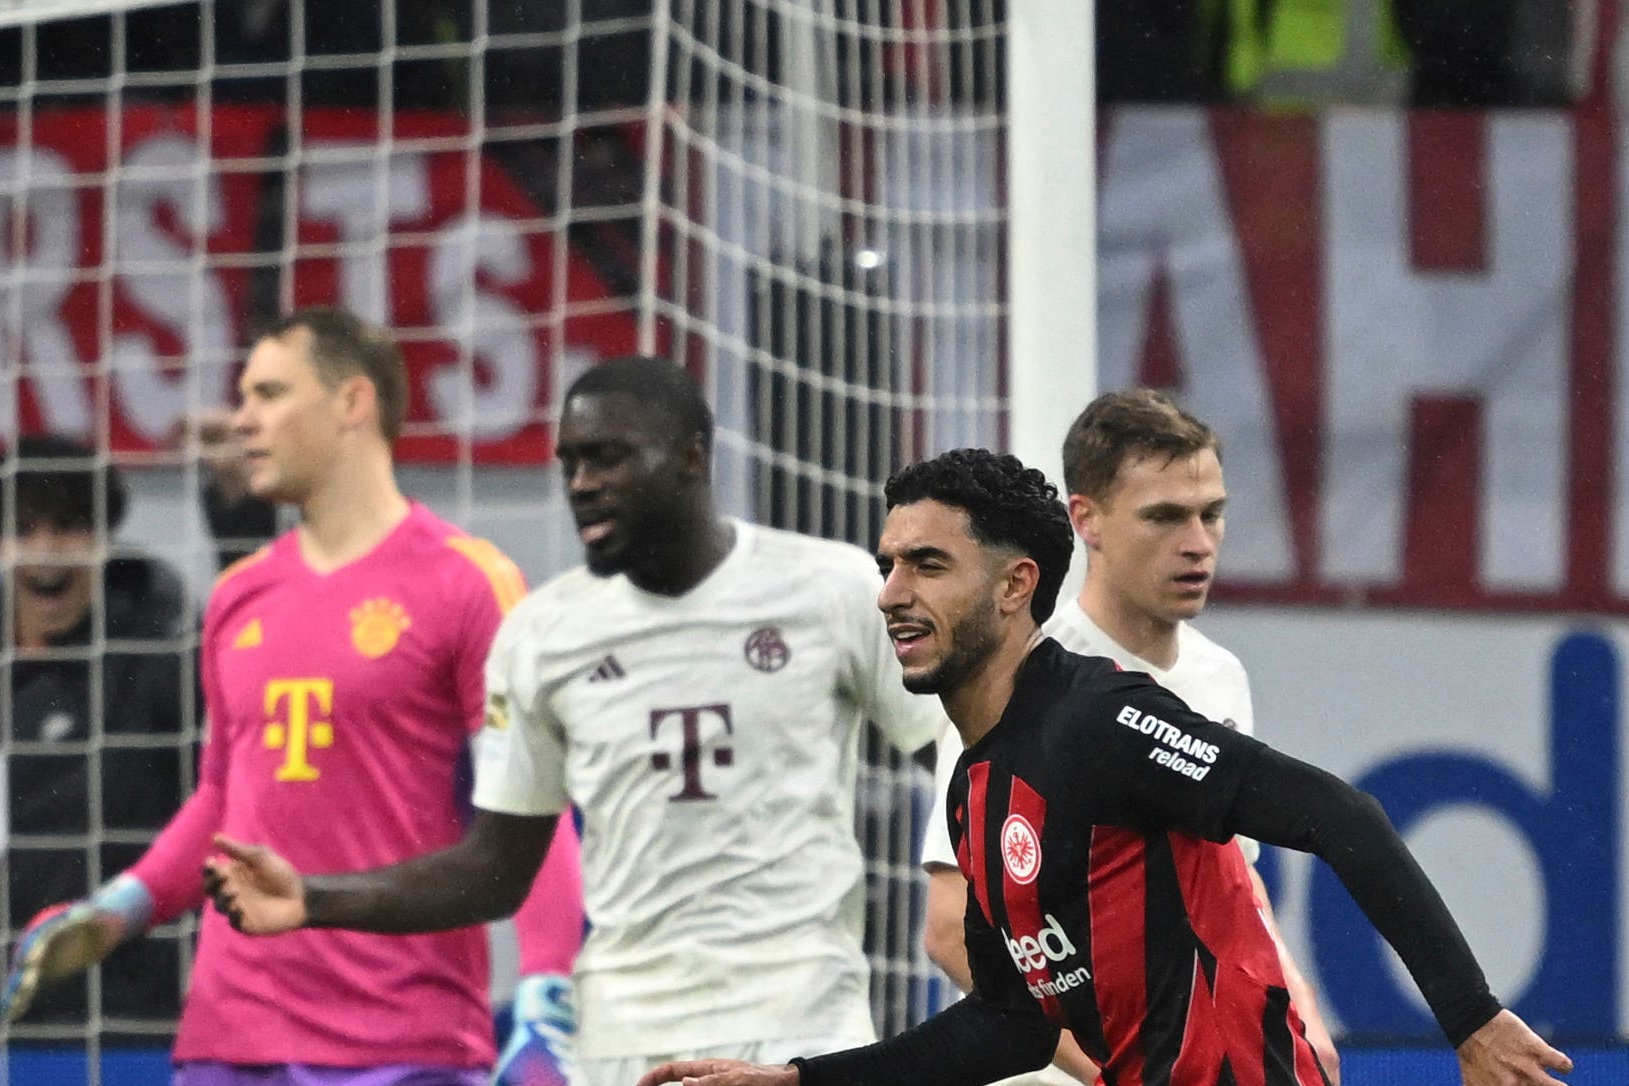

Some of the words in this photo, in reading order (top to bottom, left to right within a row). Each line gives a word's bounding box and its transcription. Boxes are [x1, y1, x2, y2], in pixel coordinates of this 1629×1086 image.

[263, 678, 334, 782] T
[649, 704, 734, 802] T
[1116, 705, 1220, 764] ELOTRANS
[1148, 747, 1211, 782] reload
[1001, 914, 1077, 975] eed
